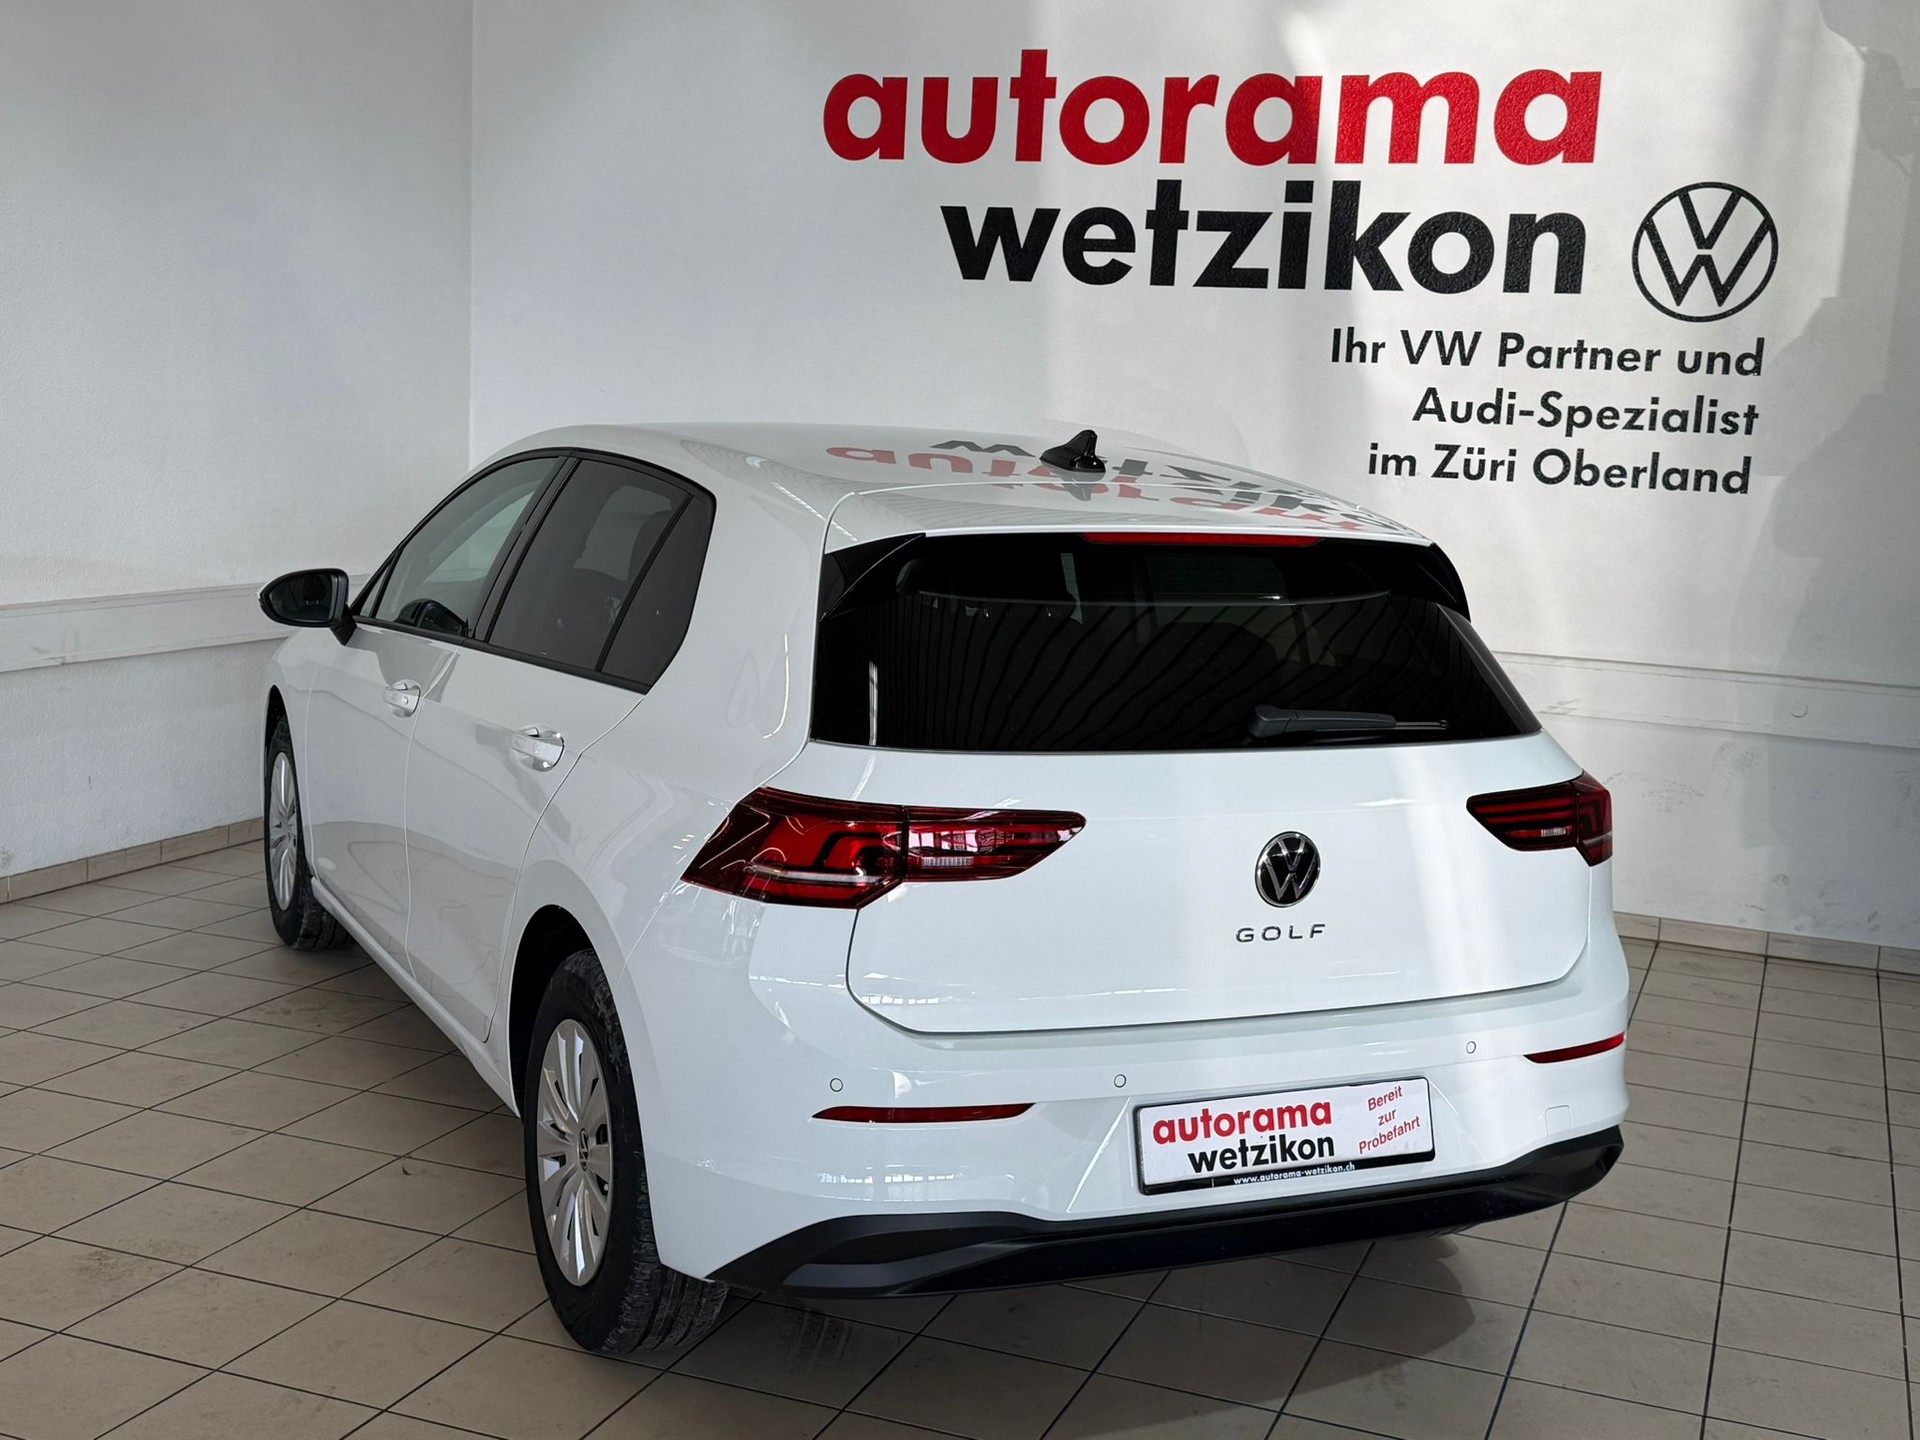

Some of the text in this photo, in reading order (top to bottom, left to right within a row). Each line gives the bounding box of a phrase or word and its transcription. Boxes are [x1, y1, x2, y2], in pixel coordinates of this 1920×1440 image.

[824, 49, 1601, 165] autorama
[940, 180, 1585, 294] wetzikon
[1332, 327, 1765, 377] Ihr VW Partner und
[1411, 387, 1760, 437] Audi-Spezialist
[1368, 442, 1752, 495] im Züri Oberland
[1236, 923, 1326, 943] GOLF
[1367, 1086, 1403, 1111] Bereit
[1378, 1109, 1397, 1126] zur
[1153, 1101, 1332, 1144] autorama
[1359, 1116, 1420, 1154] Probefahrt
[1187, 1133, 1335, 1173] wetzikon
[1233, 1162, 1356, 1185] www.autorama-wetzikon.ch
